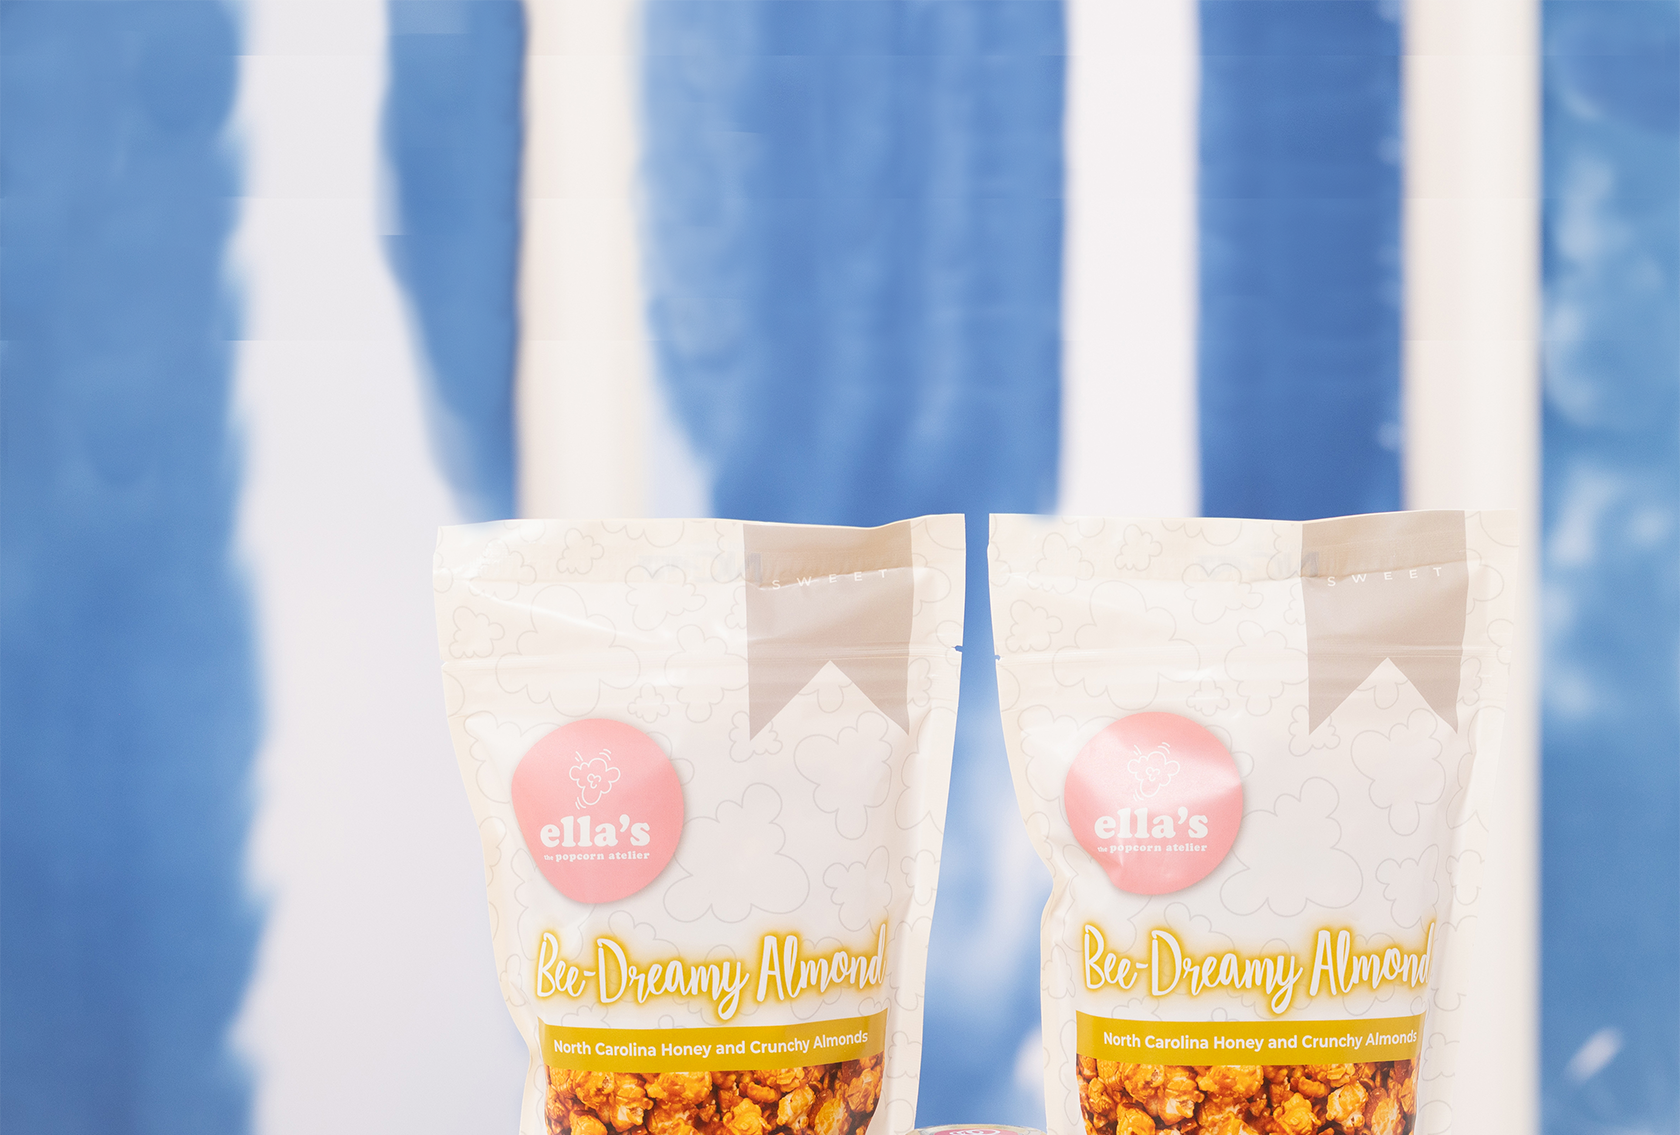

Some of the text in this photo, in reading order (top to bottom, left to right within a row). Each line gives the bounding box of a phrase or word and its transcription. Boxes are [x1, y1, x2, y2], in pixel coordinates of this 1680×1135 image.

[771, 568, 888, 590] SWEET
[1327, 566, 1444, 587] SWEET
[540, 814, 650, 848] ella's
[1094, 806, 1209, 839] ella's
[555, 852, 605, 862] popcorn
[608, 850, 651, 860] atelier
[1109, 844, 1162, 853] popcorn
[1166, 843, 1208, 852] atelier
[536, 923, 887, 1021] Bee-Dreamy Almond
[1084, 922, 1435, 1014] Bee-Dreamy Almond
[553, 1030, 869, 1058] North Carolina Honey and Crunchy Almonds
[1103, 1030, 1418, 1052] North Carolina Honey and Crunchy Almonds
